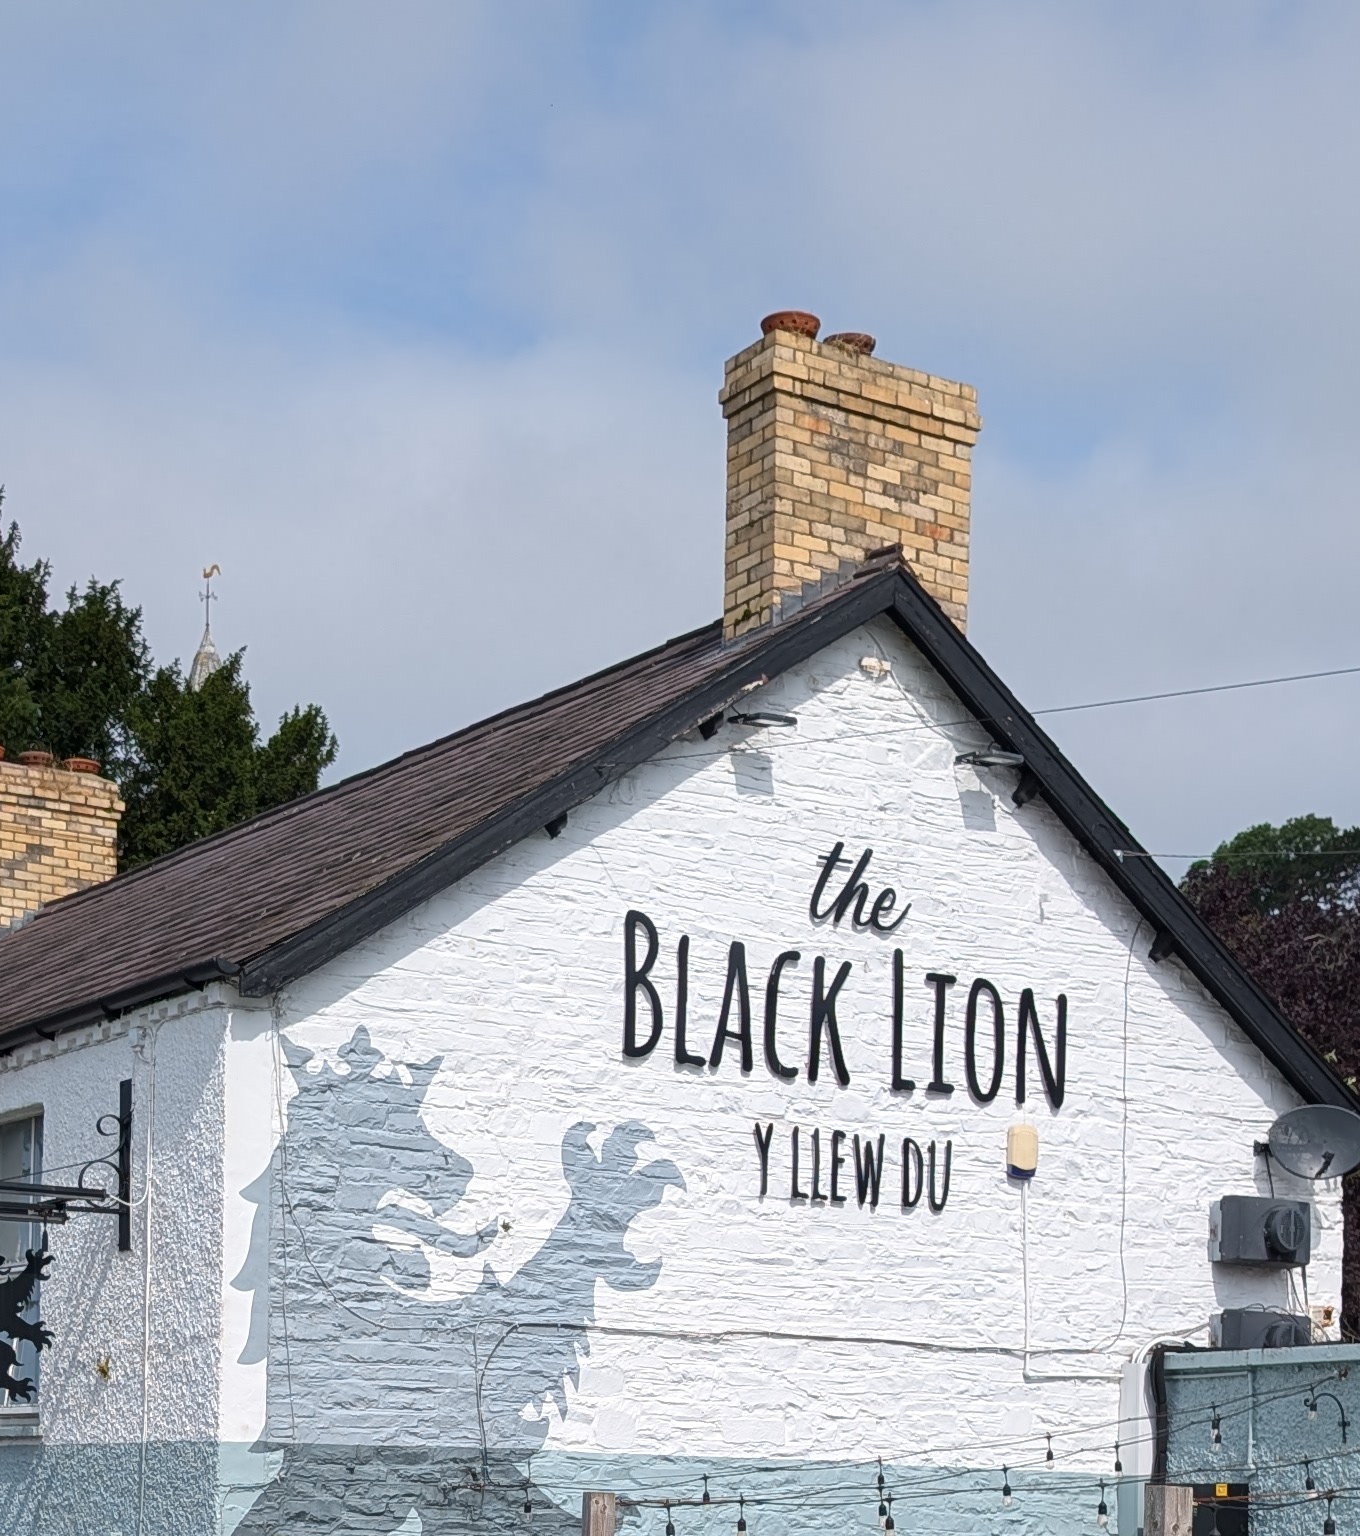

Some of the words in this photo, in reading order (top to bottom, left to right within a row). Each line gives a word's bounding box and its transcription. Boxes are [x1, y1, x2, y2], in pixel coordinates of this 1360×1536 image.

[809, 841, 912, 931] the
[622, 909, 854, 1086] BLACK
[891, 947, 1068, 1109] LION
[754, 1122, 774, 1196] Y
[791, 1126, 886, 1208] LLEW
[901, 1137, 953, 1211] DU
